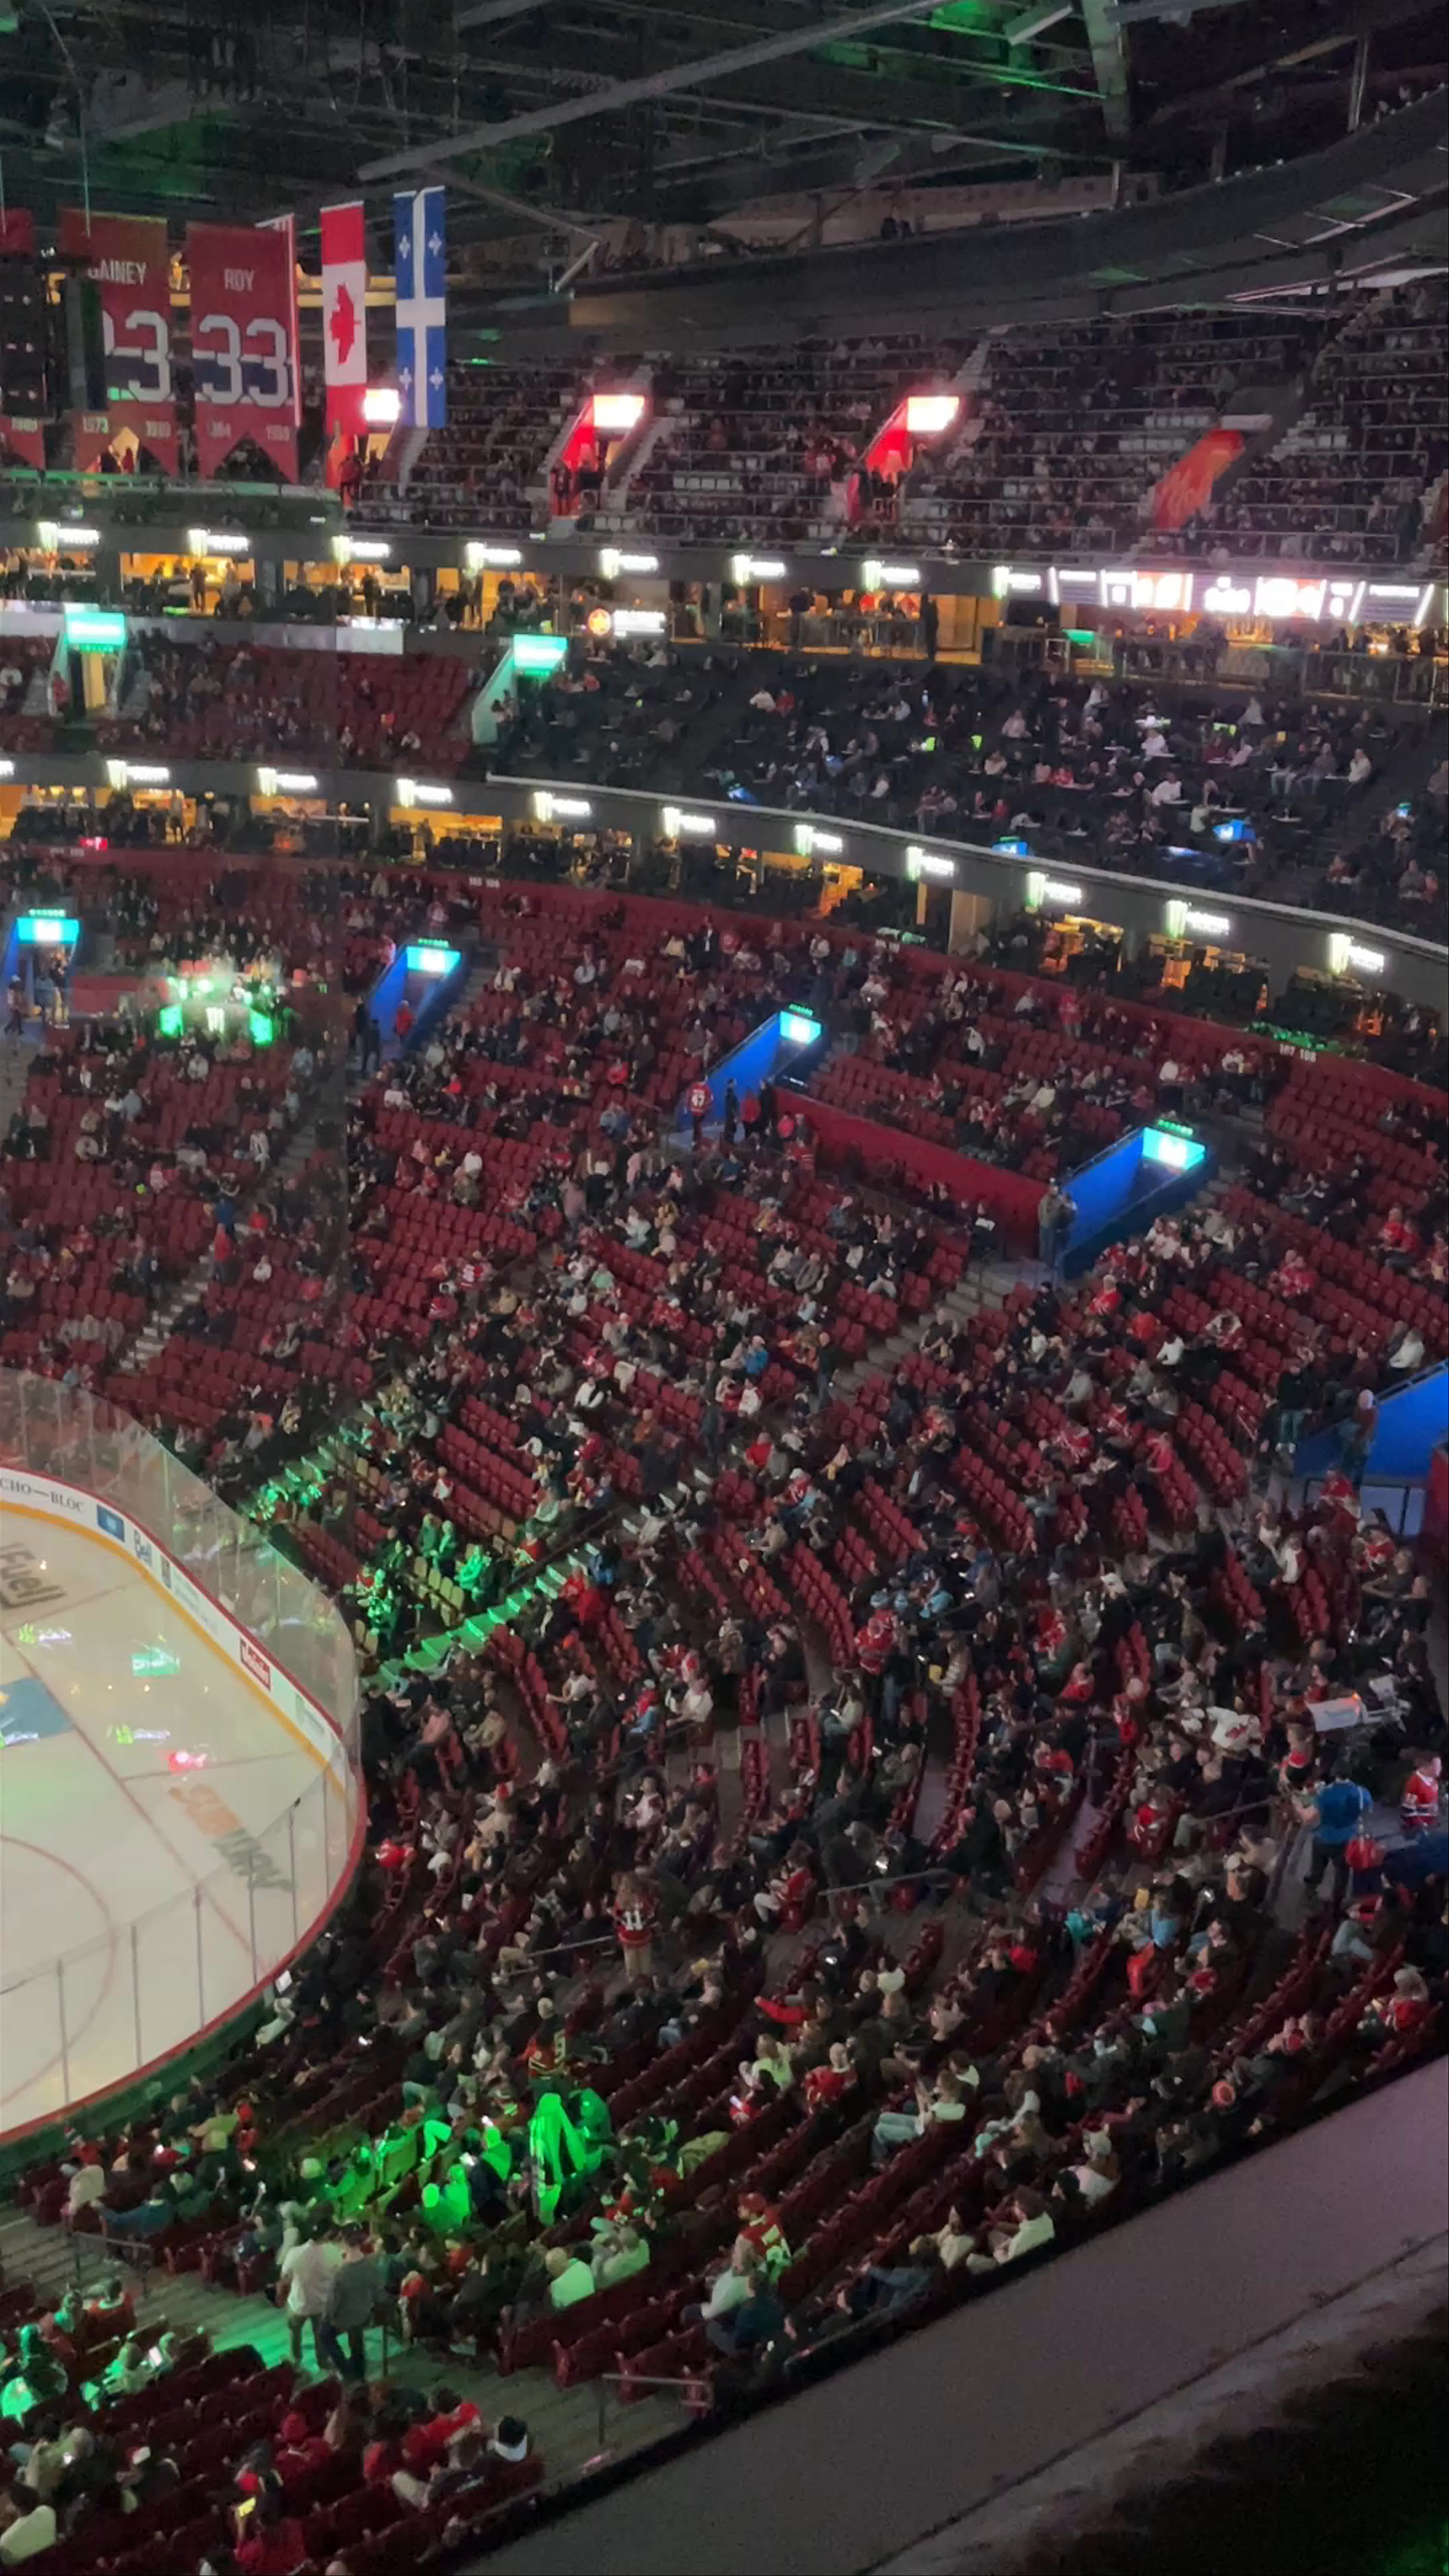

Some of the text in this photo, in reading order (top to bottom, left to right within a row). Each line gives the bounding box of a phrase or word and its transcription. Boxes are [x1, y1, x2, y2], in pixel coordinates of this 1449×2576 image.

[225, 268, 254, 292] ROY
[103, 310, 171, 402] 3
[200, 315, 288, 407] 33
